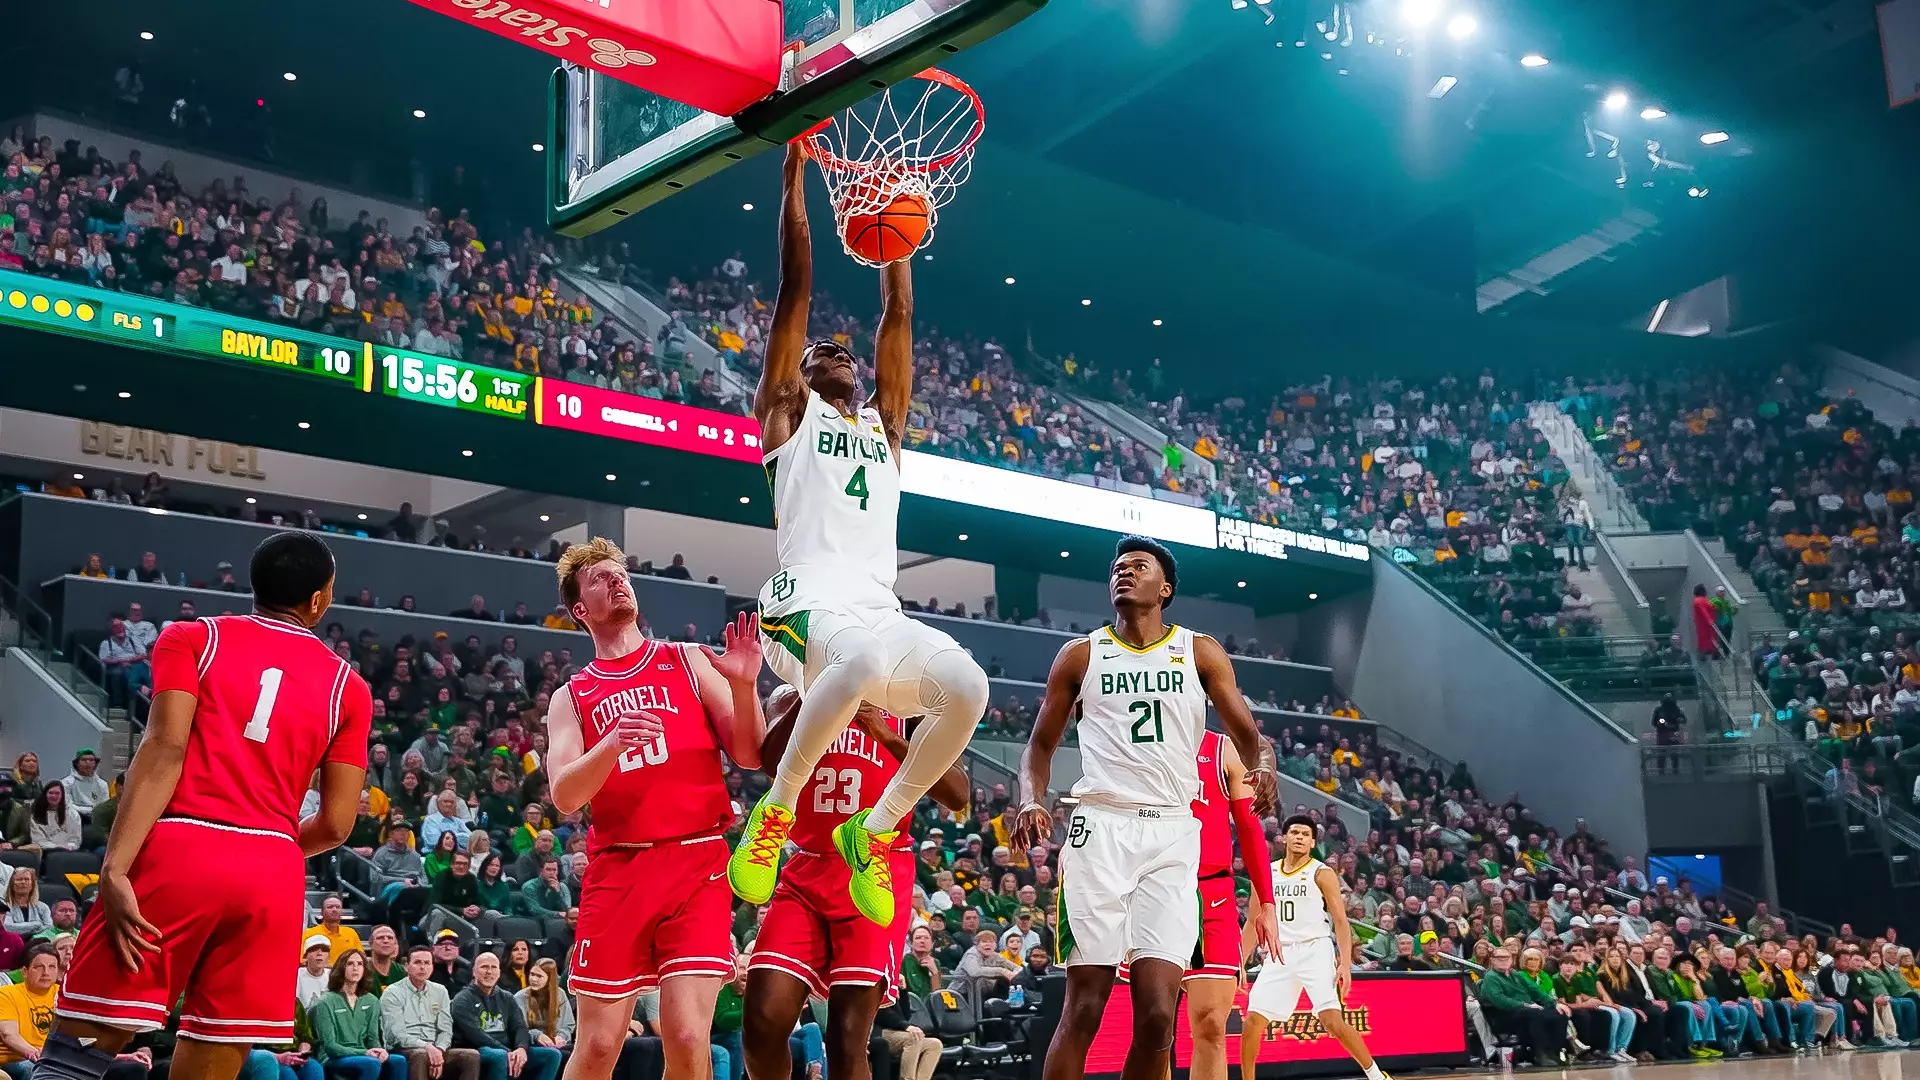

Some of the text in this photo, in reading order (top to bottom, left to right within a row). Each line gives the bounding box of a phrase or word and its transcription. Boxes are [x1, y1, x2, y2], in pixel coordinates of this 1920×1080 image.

[113, 312, 163, 337] FLS 1
[221, 329, 350, 375] BAYLOR 10
[382, 354, 478, 404] 15:56
[491, 377, 521, 396] 1ST
[485, 394, 528, 414] HALF
[556, 393, 582, 419] 10
[81, 420, 266, 480] BEAR FUEL
[723, 428, 735, 446] 2
[817, 430, 887, 463] BAYLOR
[844, 464, 869, 511] 4
[1101, 670, 1184, 695] BAYLOR
[243, 667, 284, 744] 1
[591, 685, 679, 736] CORNELL
[1128, 699, 1165, 744] 21
[824, 728, 884, 768] NELL
[814, 766, 862, 815] 23
[1138, 808, 1161, 819] BEARS
[1274, 884, 1307, 897] AYLOR
[1280, 900, 1295, 922] 10
[579, 938, 591, 968] C
